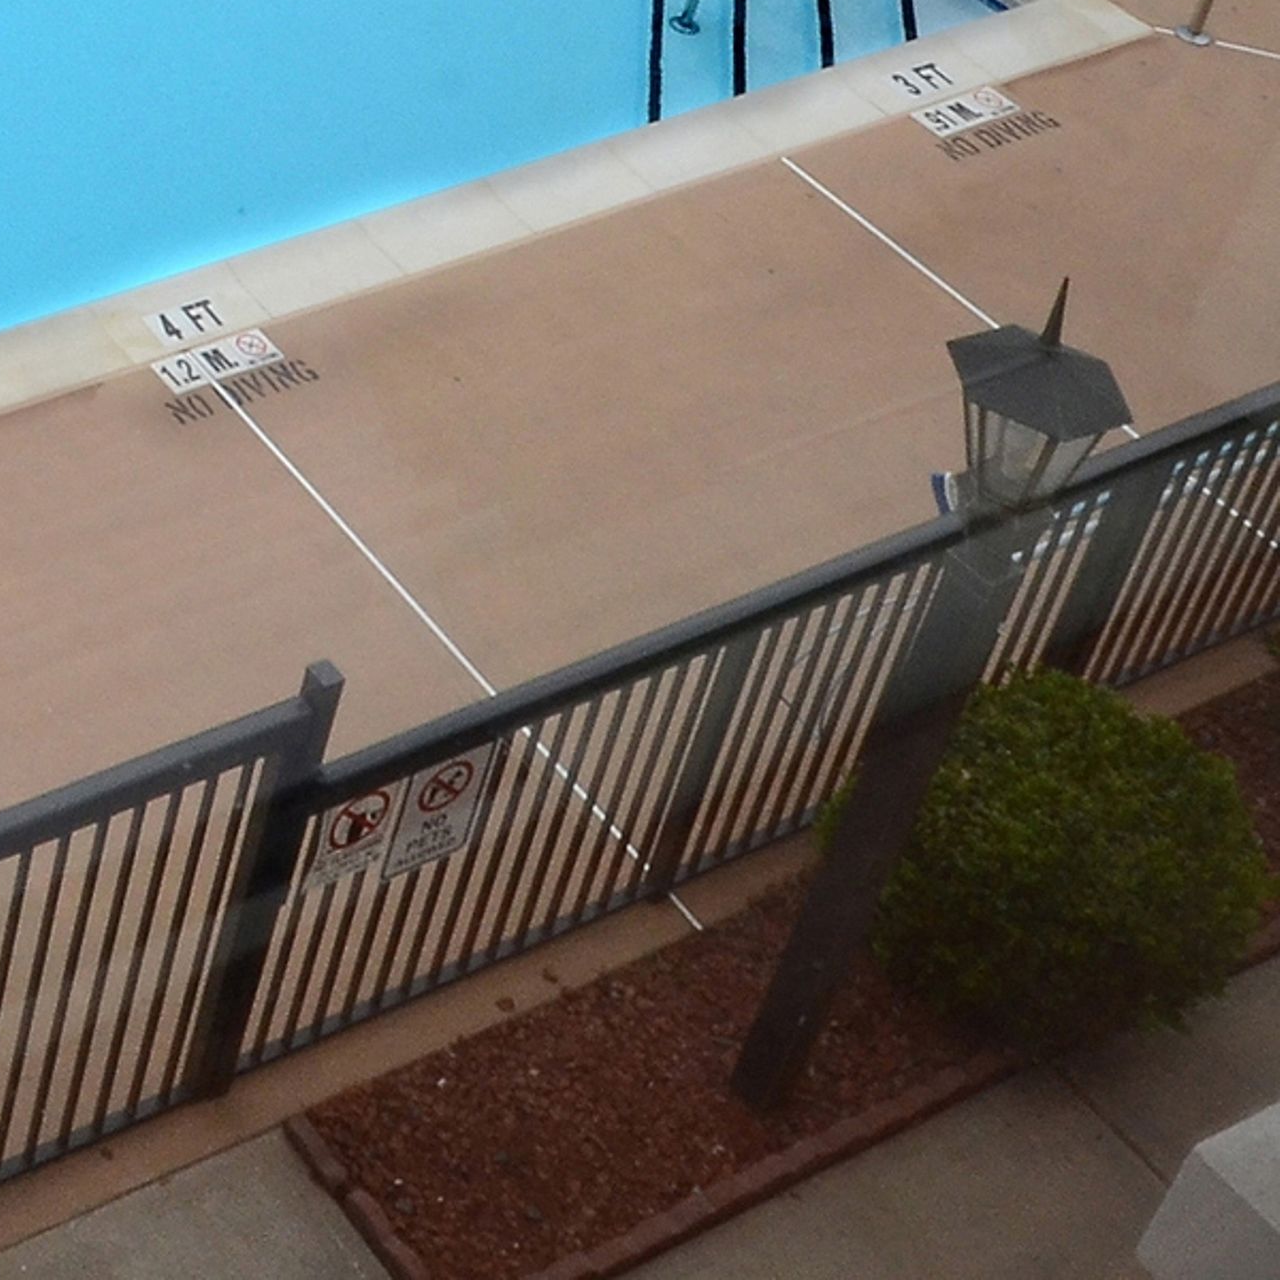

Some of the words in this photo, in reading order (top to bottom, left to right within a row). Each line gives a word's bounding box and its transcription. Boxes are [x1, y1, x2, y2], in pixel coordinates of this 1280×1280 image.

[892, 73, 922, 96] 3
[913, 62, 954, 89] FT
[936, 136, 981, 160] NO
[973, 110, 1062, 150] DIVING
[158, 313, 184, 340] 4
[181, 299, 223, 333] FT
[160, 358, 201, 387] 1.2
[200, 348, 240, 374] M.
[164, 394, 215, 425] NO
[212, 359, 320, 411] DIVING
[421, 813, 448, 834] NO
